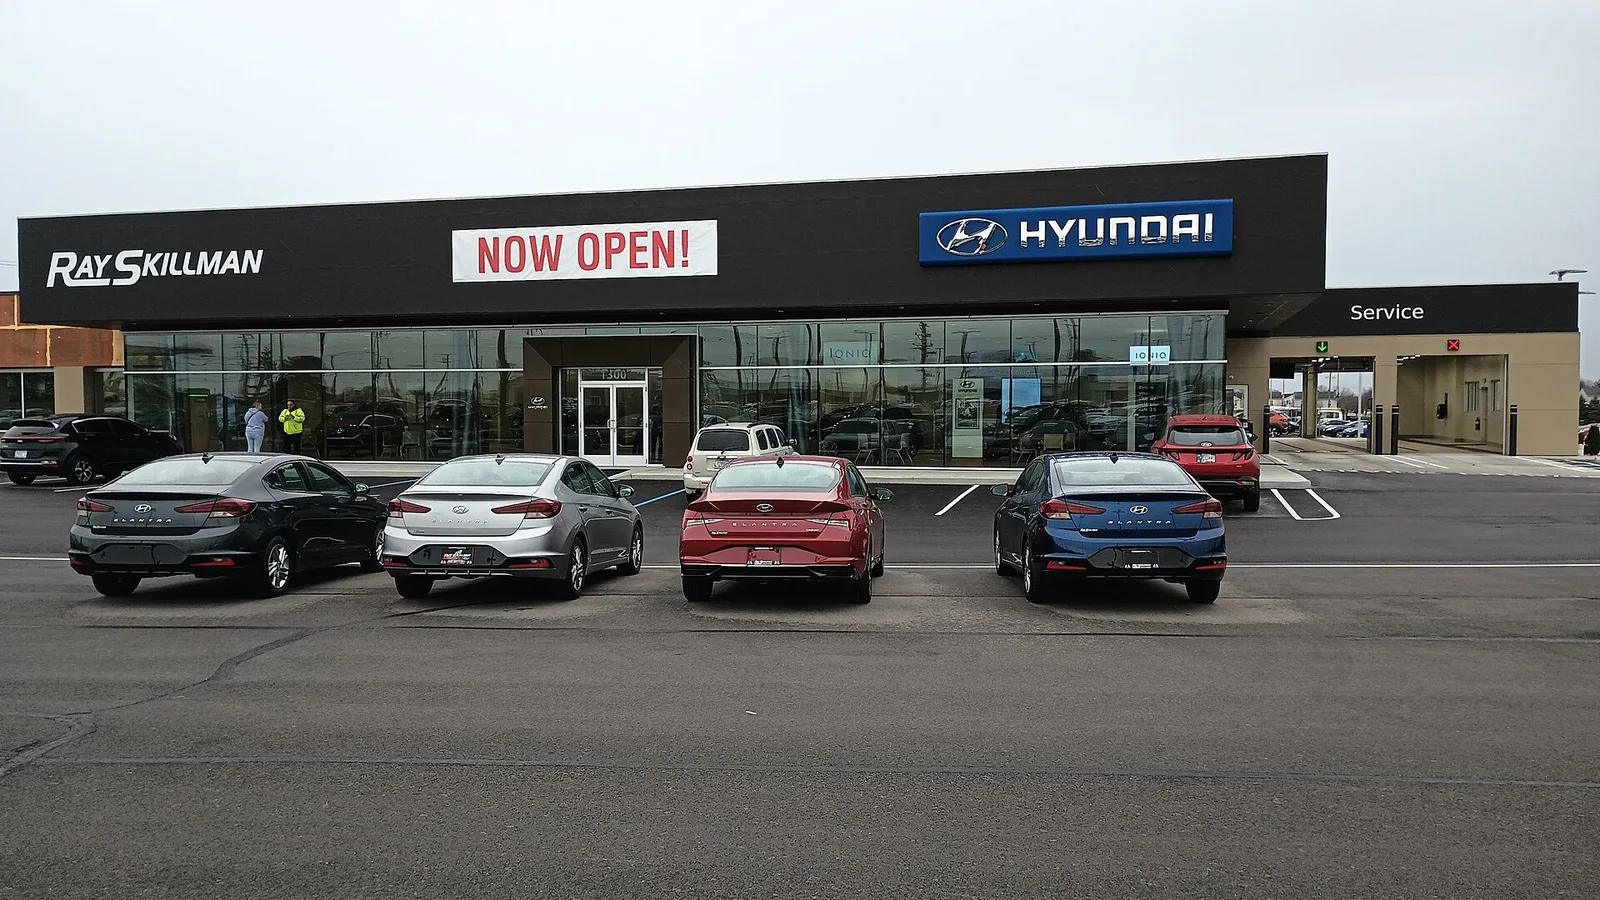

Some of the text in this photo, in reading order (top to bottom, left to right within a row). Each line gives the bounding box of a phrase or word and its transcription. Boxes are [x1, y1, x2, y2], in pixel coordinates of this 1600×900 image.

[1020, 213, 1213, 249] HYUNDAI
[46, 249, 264, 288] RAY SKILLMAN
[477, 229, 689, 274] NOW OPEN!
[1350, 303, 1424, 320] Service
[602, 369, 627, 380] 1300
